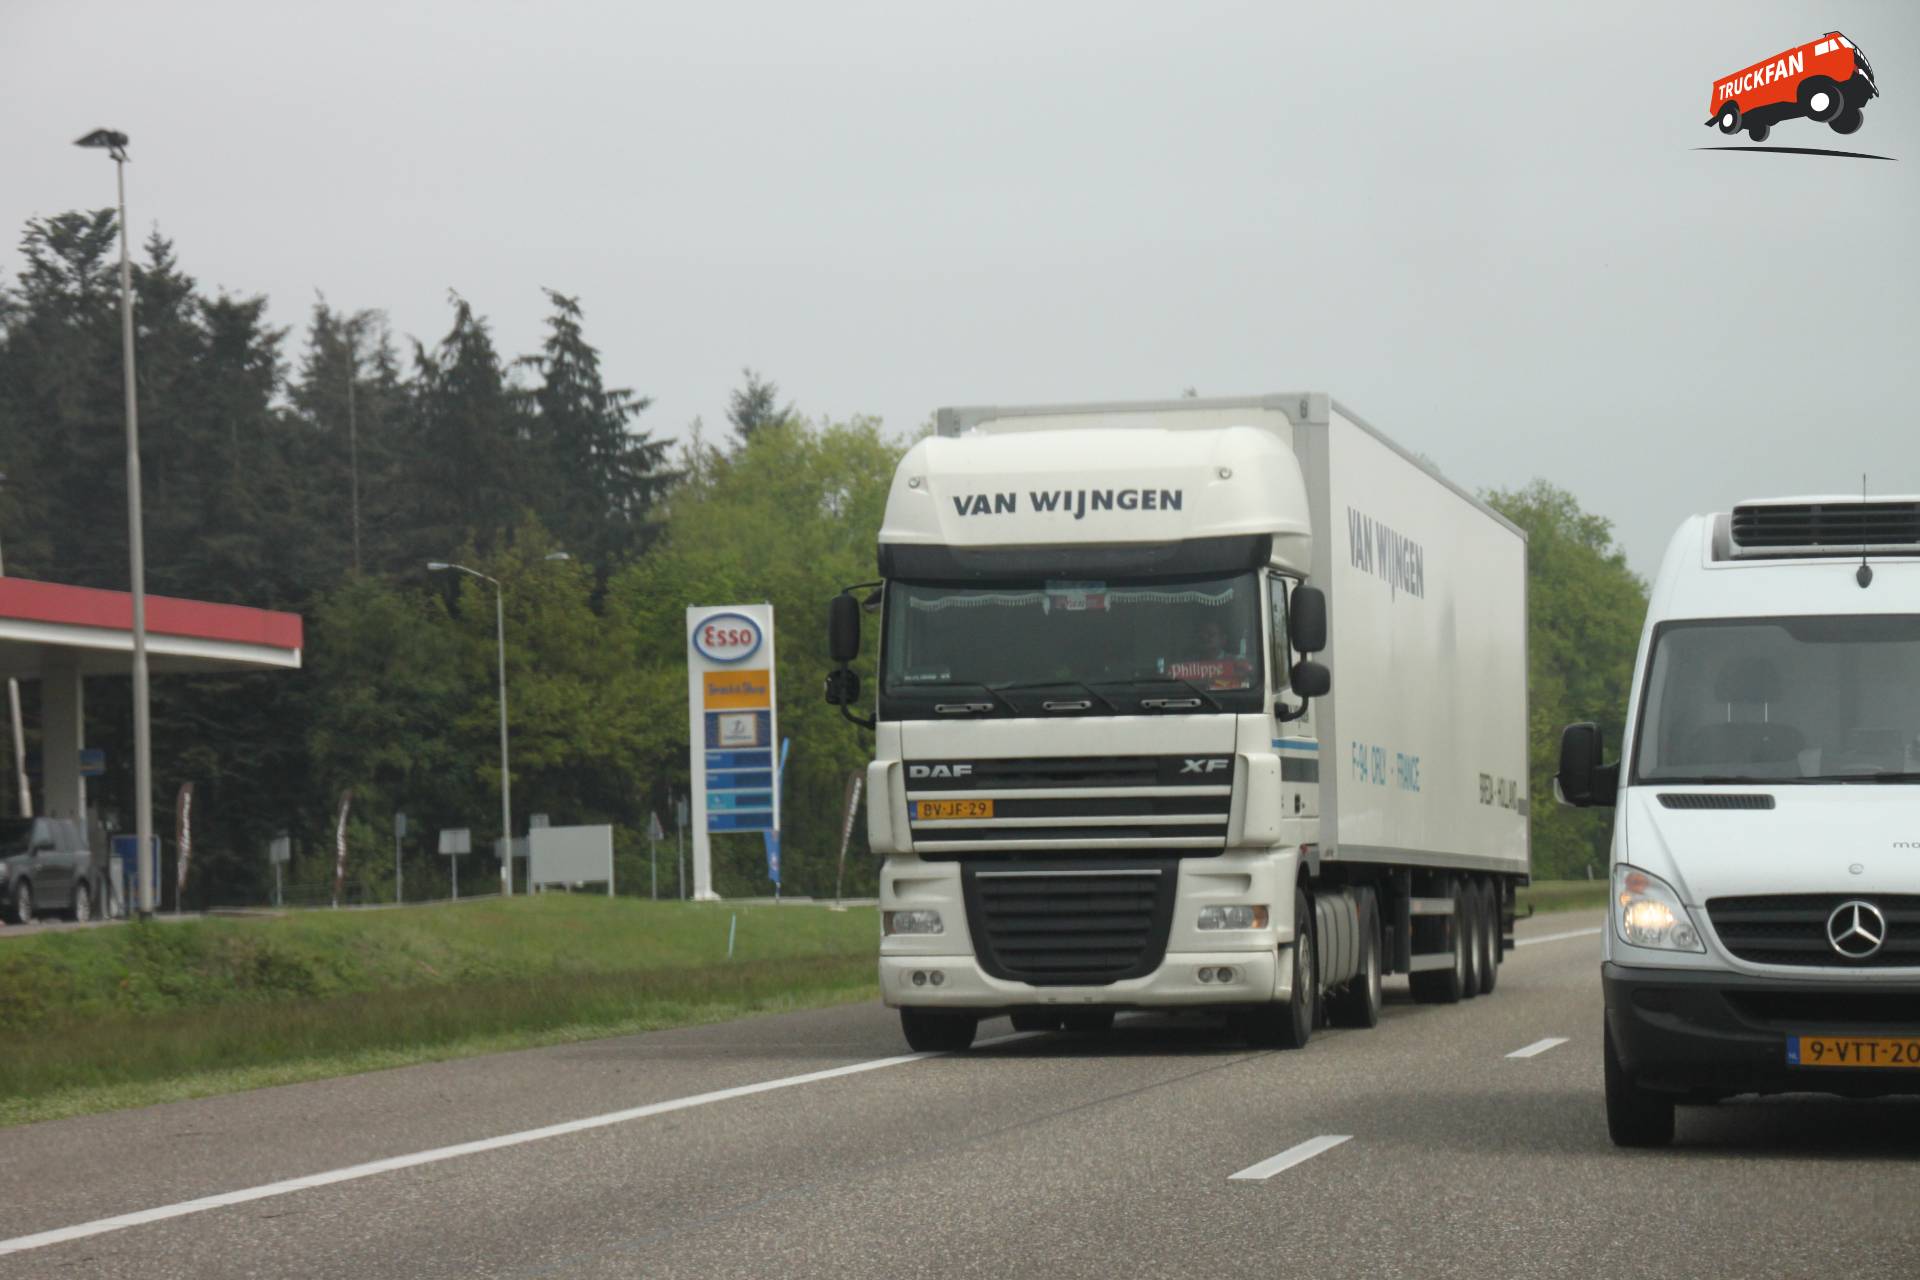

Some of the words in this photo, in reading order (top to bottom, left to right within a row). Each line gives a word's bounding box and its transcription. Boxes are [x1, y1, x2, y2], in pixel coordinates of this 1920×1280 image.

[952, 492, 1016, 516] VAN
[1029, 489, 1183, 520] WIJNGEN
[1347, 505, 1374, 575] VAN
[1375, 520, 1424, 604] WIJNGEN
[909, 764, 973, 779] DAF
[1180, 759, 1230, 773] XF
